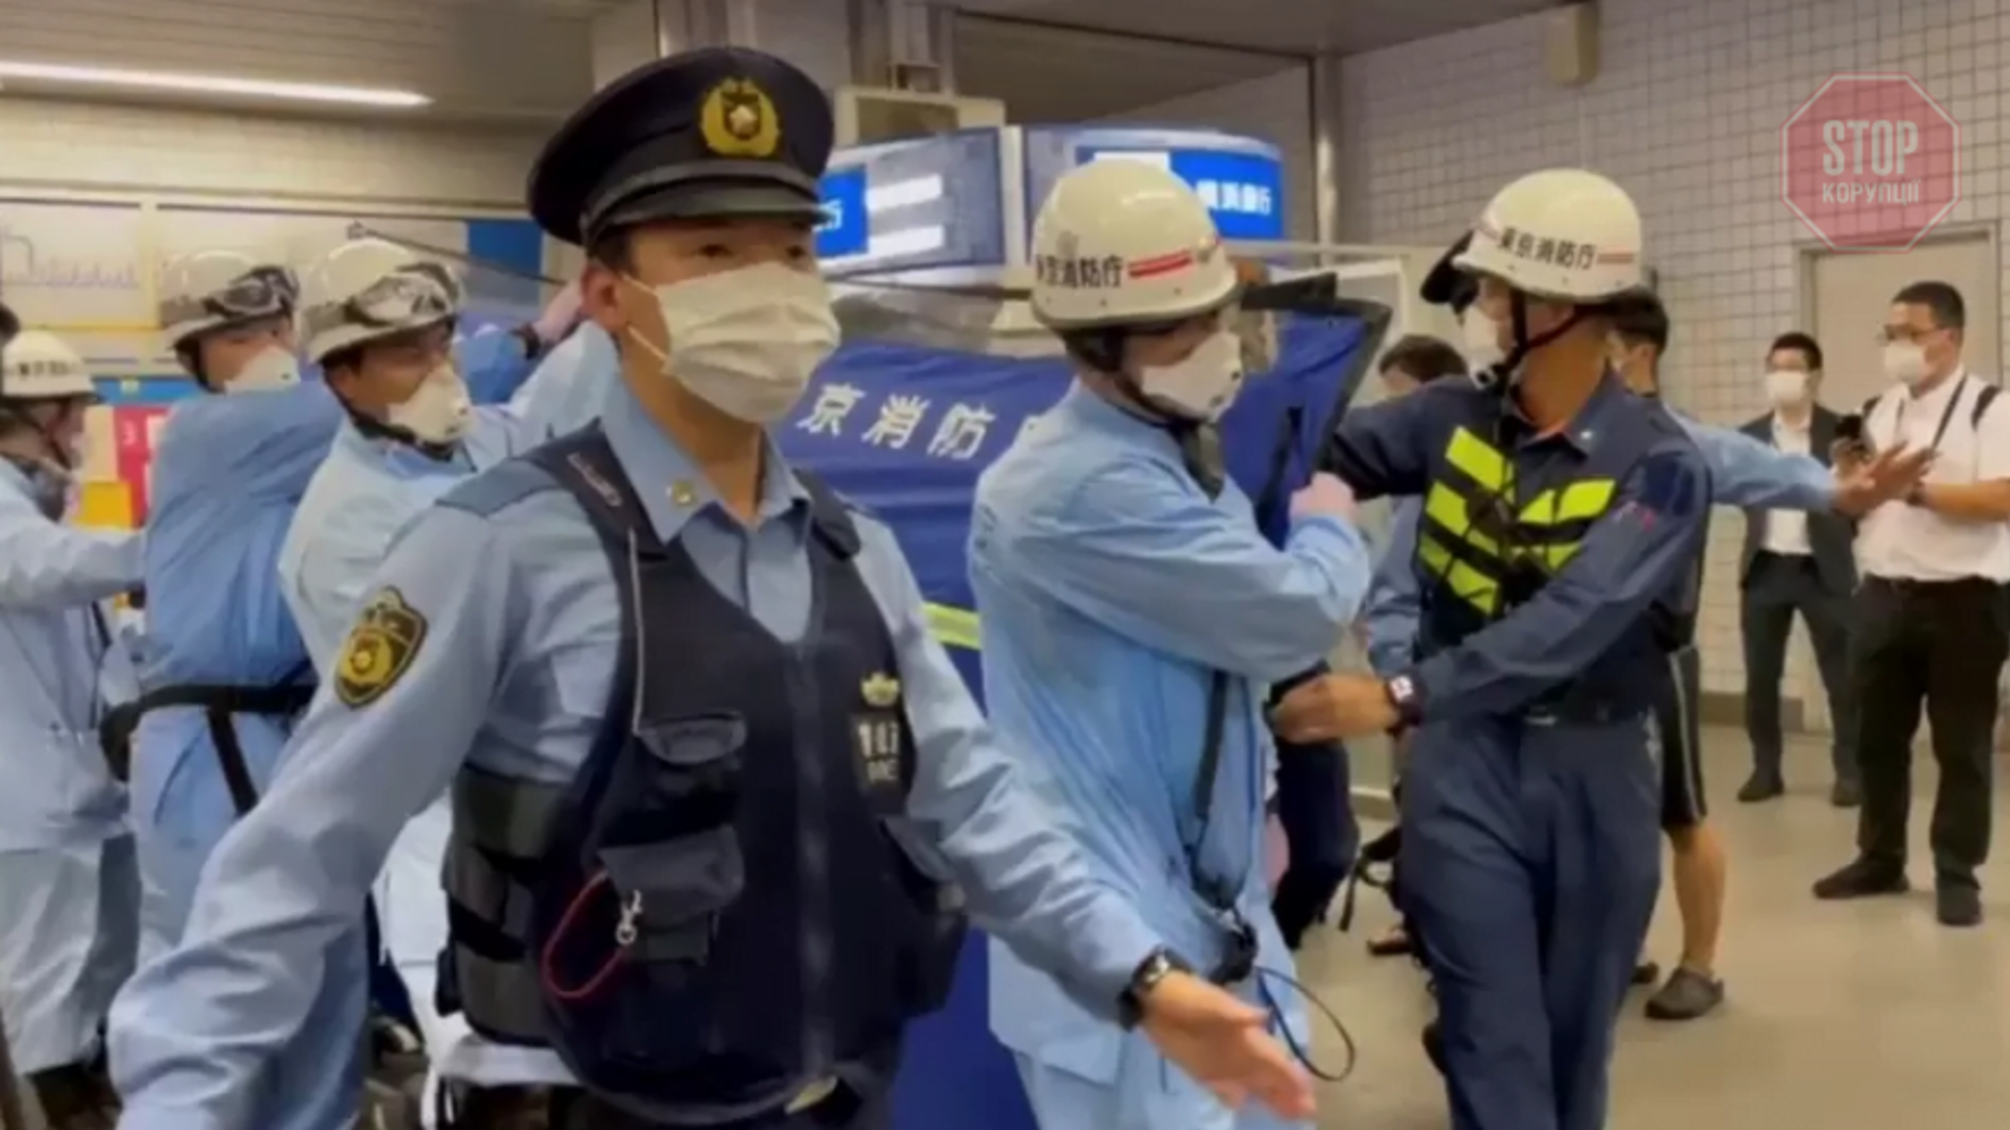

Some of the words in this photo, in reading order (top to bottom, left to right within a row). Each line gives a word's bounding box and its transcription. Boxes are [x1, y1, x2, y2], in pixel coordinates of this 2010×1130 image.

[1498, 227, 1595, 269] 東京消防庁
[796, 383, 1040, 459] 京消防
